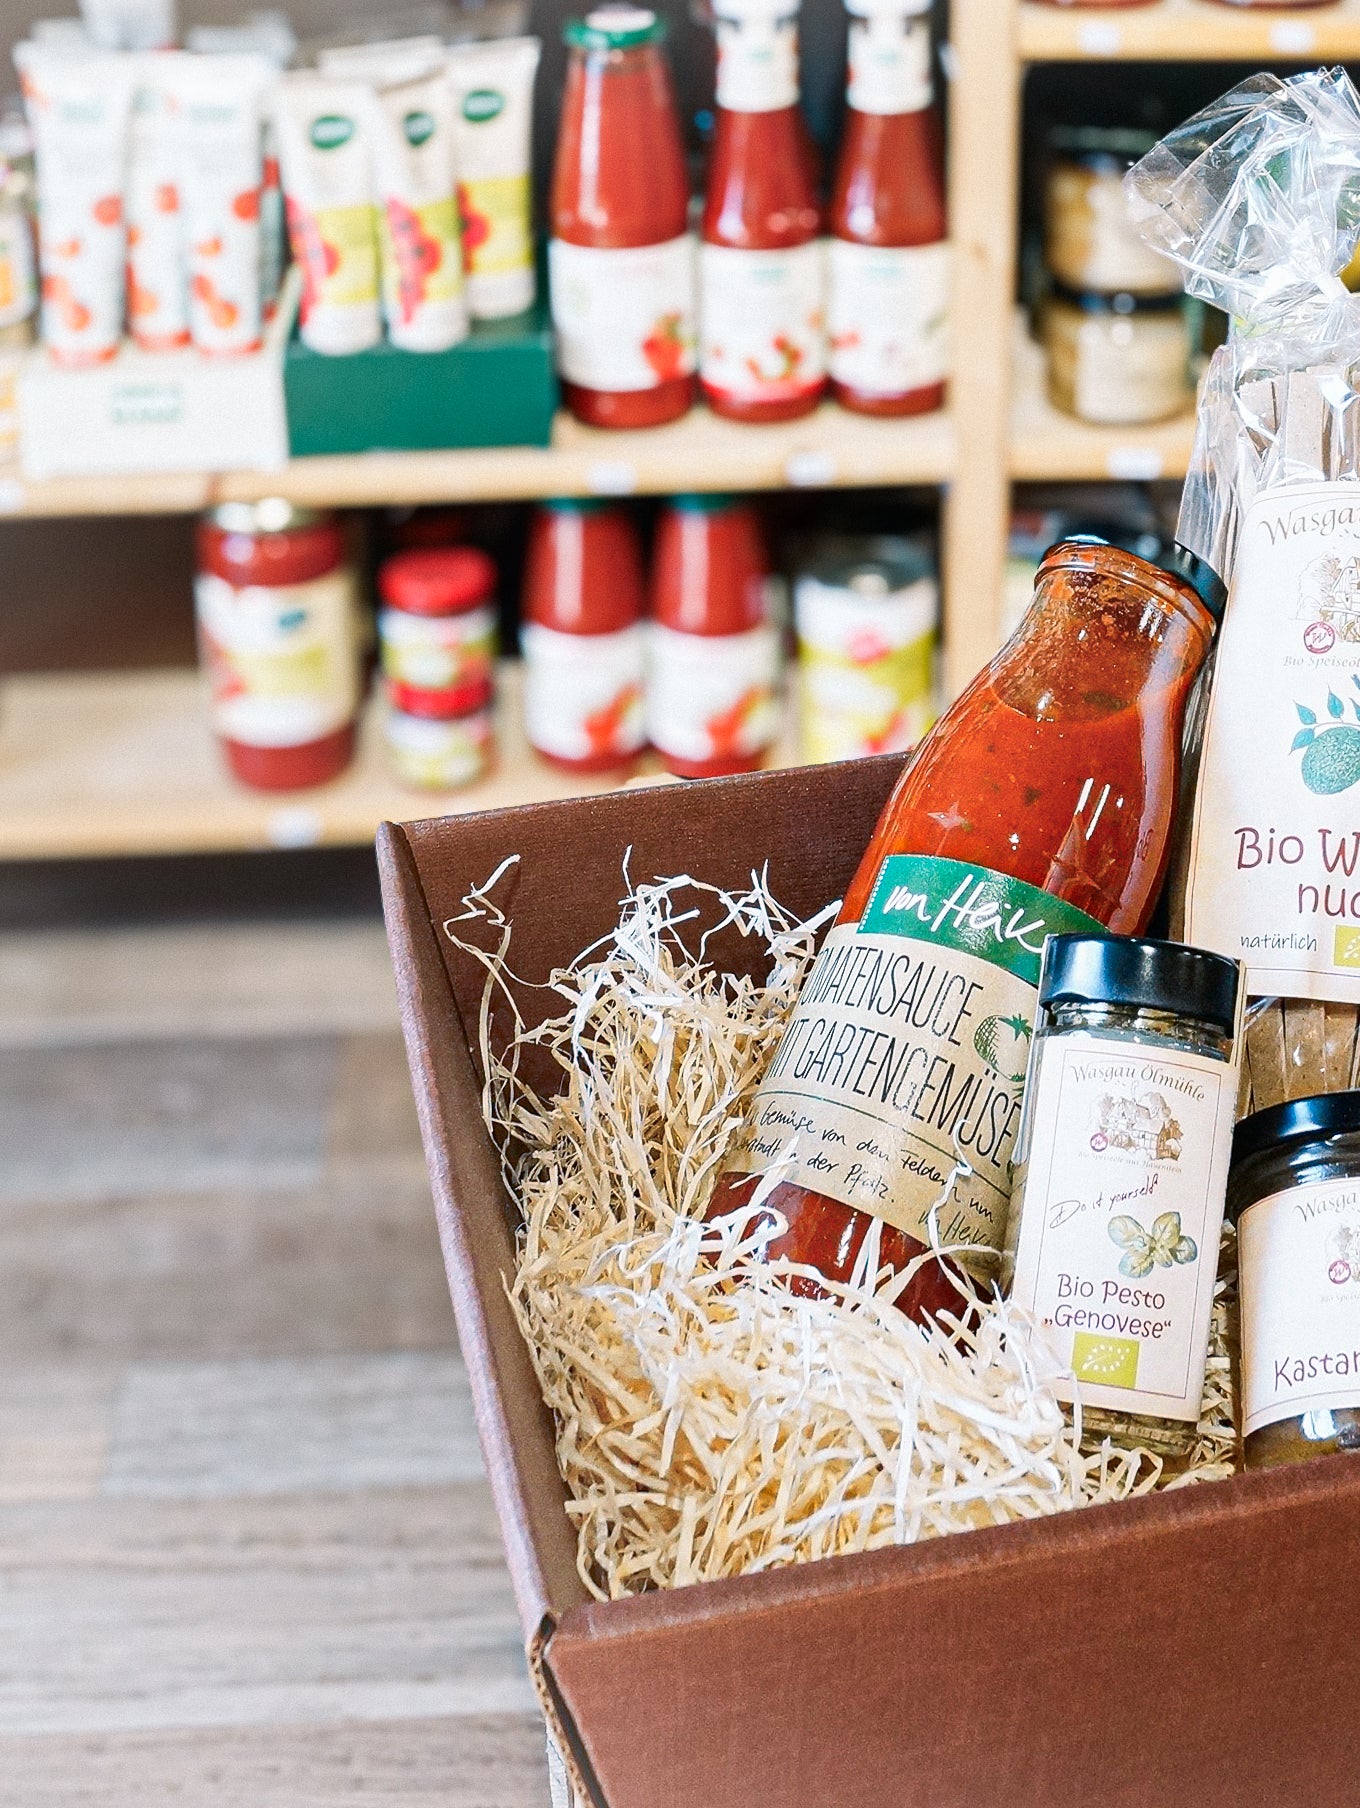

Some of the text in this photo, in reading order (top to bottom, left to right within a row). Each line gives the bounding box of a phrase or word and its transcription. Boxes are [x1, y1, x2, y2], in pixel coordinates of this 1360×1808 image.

[1283, 655, 1304, 667] Bio
[1234, 828, 1305, 871] Bio
[883, 873, 1046, 954] von Heik
[1240, 932, 1317, 952] natürlich
[800, 945, 983, 1047] OMATENSAUCE
[794, 1017, 1023, 1168] GARTENGEMÜSE
[1070, 1064, 1205, 1102] Wasgau Ölmühle
[821, 1128, 847, 1146] von
[806, 1151, 840, 1174] der
[1108, 1173, 1158, 1212] yourself
[1057, 1273, 1166, 1310] Bio Pesto
